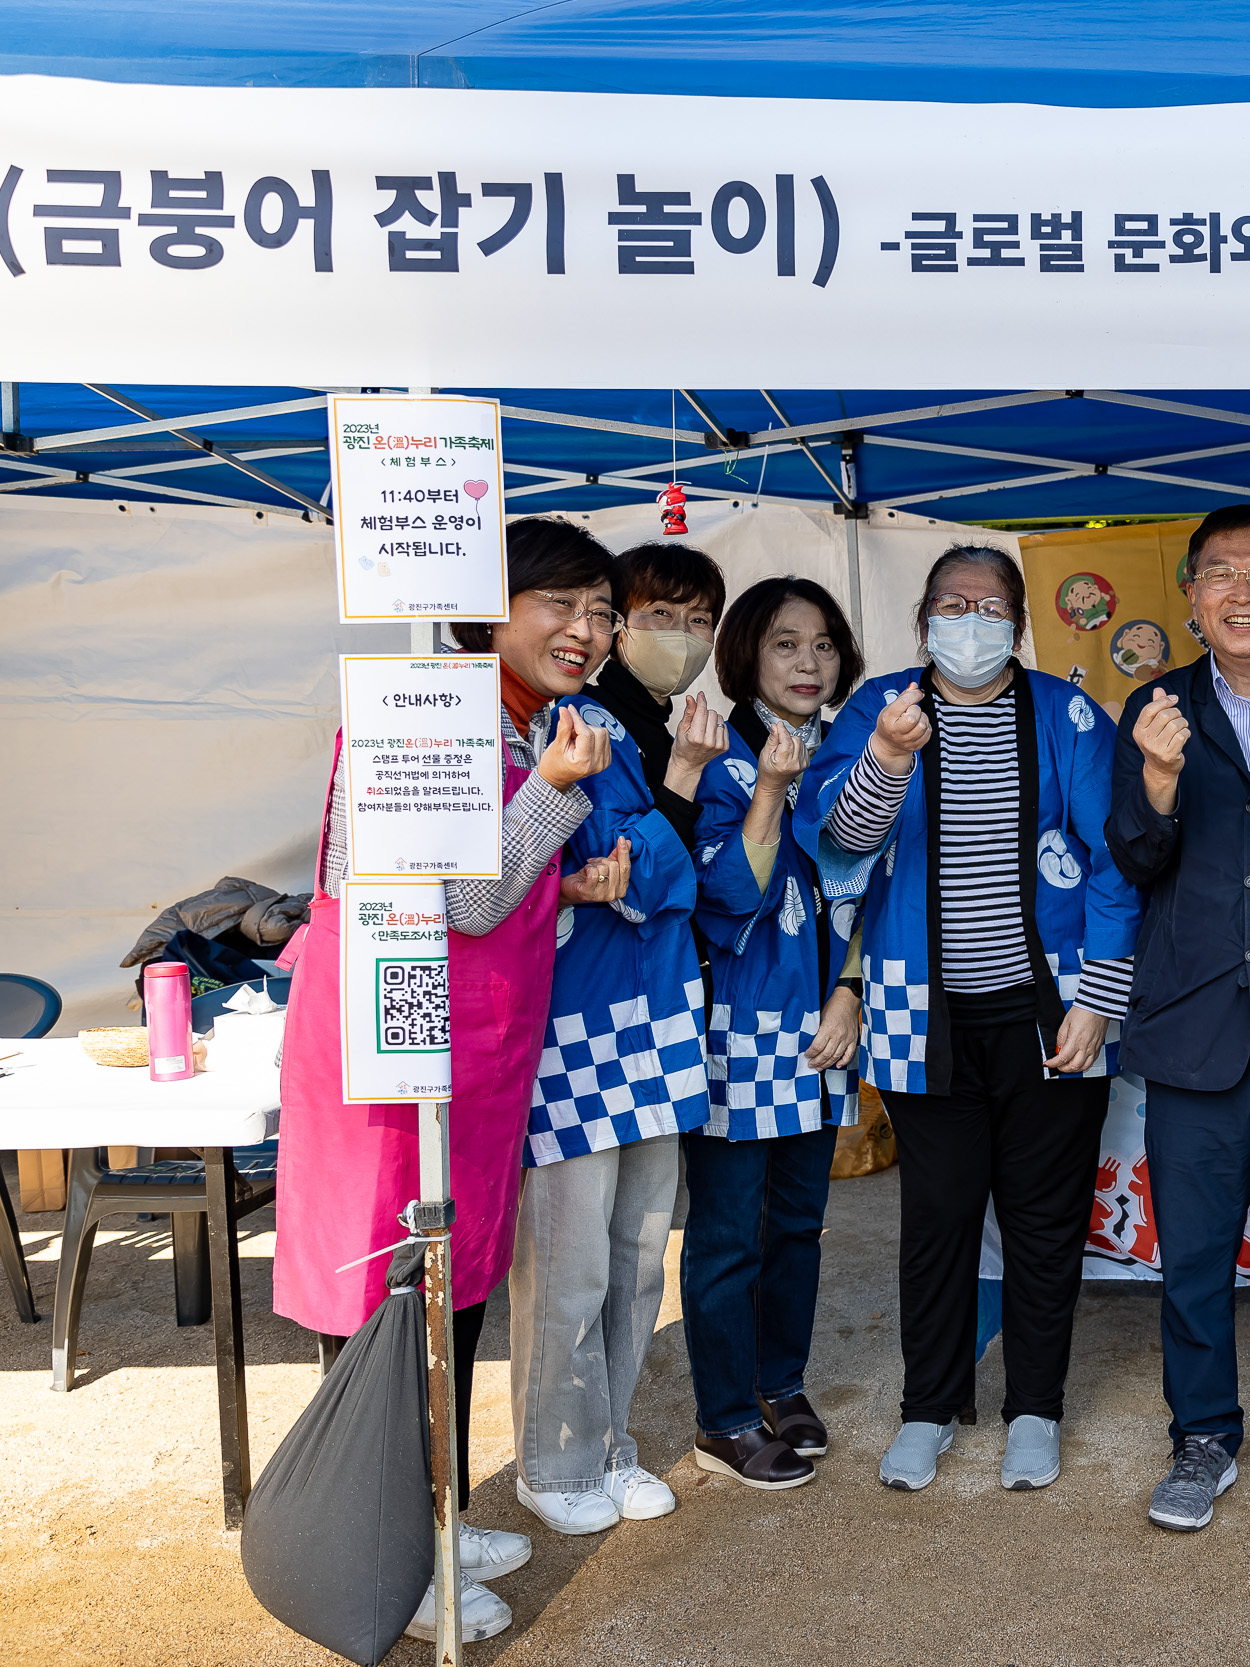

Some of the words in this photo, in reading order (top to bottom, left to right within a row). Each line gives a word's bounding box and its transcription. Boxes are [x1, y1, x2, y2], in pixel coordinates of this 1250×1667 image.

[0, 164, 334, 278] (금붕어
[373, 171, 566, 275] 잡기
[607, 173, 841, 289] 놀이)
[880, 210, 1086, 274] -글로벌
[342, 423, 380, 434] 2023년
[342, 435, 371, 450] 광진
[439, 436, 495, 451] 가족축제
[380, 489, 459, 504] 11:40부터
[360, 515, 427, 531] 체험부스
[431, 515, 482, 531] 운영이
[378, 541, 467, 557] 시작됩니다.
[408, 603, 458, 611] 광진구가족센터
[351, 738, 385, 749] 2023년
[455, 738, 495, 748] 가족축제
[372, 754, 399, 764] 스탬프
[401, 754, 420, 764] 투어
[421, 754, 442, 764] 선물
[443, 754, 473, 764] 증정은
[375, 770, 430, 780] 공직선거법에
[431, 770, 471, 780] 의거하여
[366, 786, 420, 796] 취소되었음을
[422, 786, 484, 796] 알려드립니다.
[357, 803, 412, 812] 참여자분들의
[413, 802, 494, 812] 양해부탁드립니다.
[409, 862, 458, 870] 광진구가족센터
[358, 902, 393, 911] 2023년
[358, 913, 384, 926] 광진
